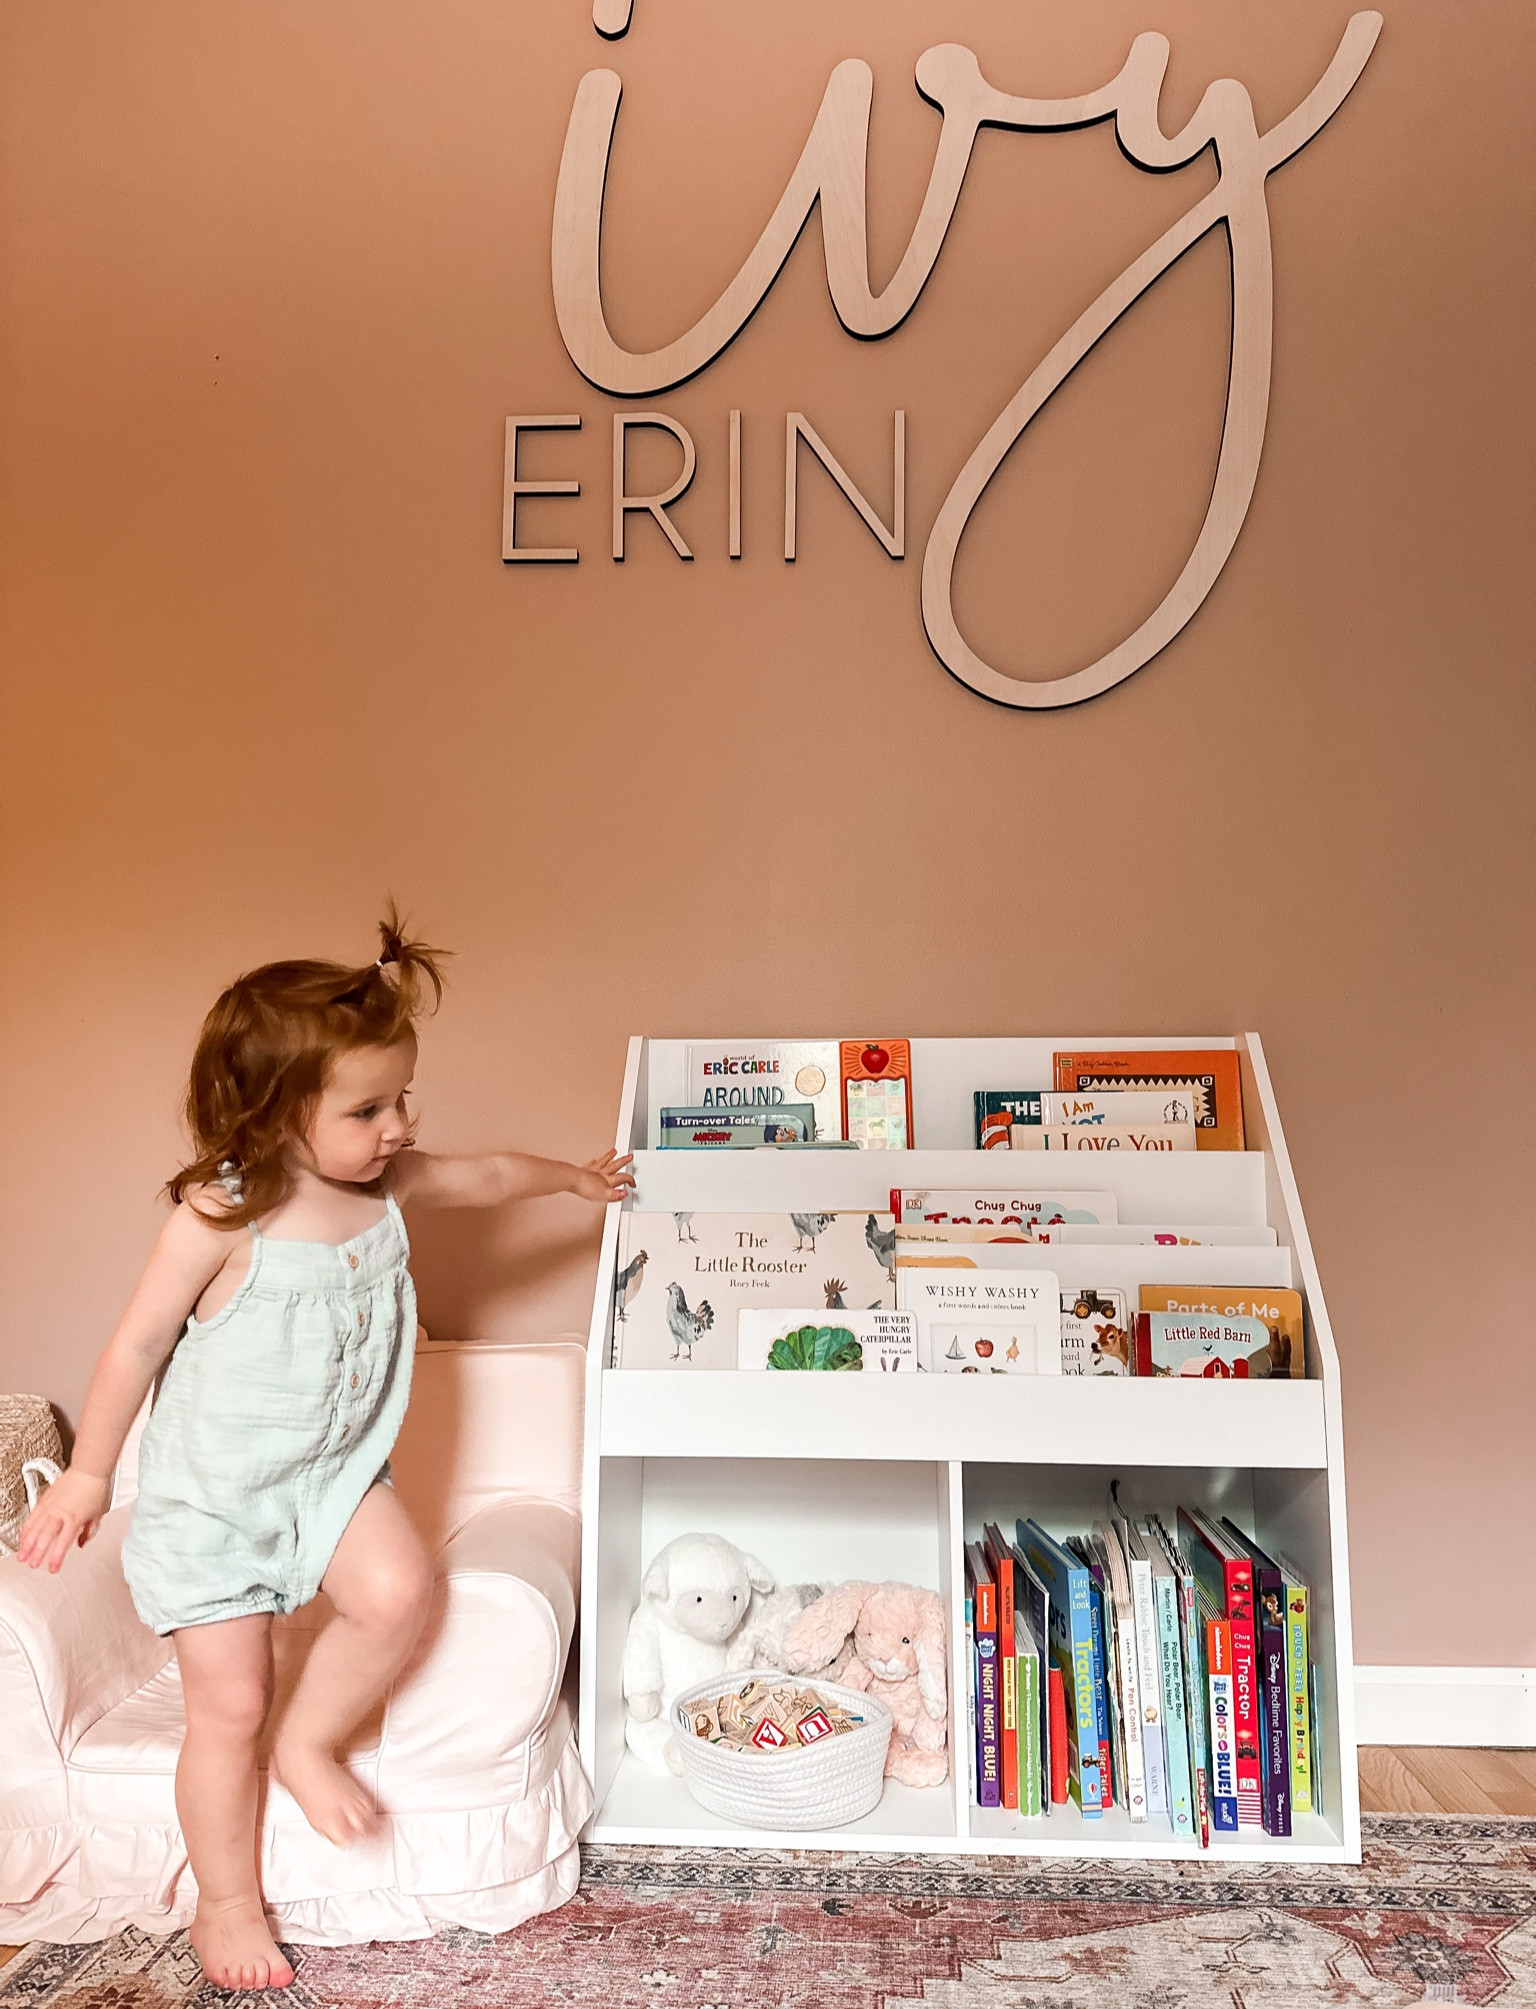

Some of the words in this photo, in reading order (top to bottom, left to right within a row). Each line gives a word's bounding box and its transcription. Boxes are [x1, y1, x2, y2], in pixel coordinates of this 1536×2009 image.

[550, 0, 1385, 712] ivy
[502, 410, 906, 564] ERIN
[741, 1060, 780, 1075] CARLE
[703, 1085, 784, 1108] AROUND
[1001, 1101, 1040, 1116] THE
[1062, 1102, 1069, 1117] I
[1072, 1099, 1094, 1116] Am
[675, 1117, 727, 1126] Turn-over
[729, 1116, 756, 1126] Tales
[1127, 1134, 1173, 1150] You
[906, 1199, 921, 1210] DK
[975, 1200, 1005, 1212] Chug
[1011, 1200, 1042, 1212] Chug
[735, 1232, 767, 1248] The
[695, 1256, 738, 1273] Little
[742, 1256, 807, 1274] Rooster
[730, 1279, 750, 1289] Rory
[926, 1285, 977, 1297] WISHY
[985, 1286, 1039, 1299] WASHY
[1166, 1300, 1219, 1315] Parts
[1224, 1302, 1246, 1317] of
[1251, 1302, 1280, 1318] Me
[873, 1316, 889, 1324] THE
[890, 1316, 911, 1324] VERY
[1066, 1320, 1081, 1330] first
[879, 1325, 911, 1334] HUNGRY
[1164, 1326, 1196, 1341] Little
[1198, 1326, 1221, 1341] Red
[1223, 1327, 1252, 1343] Barn
[860, 1335, 912, 1344] CATERPILLAR
[1061, 1337, 1085, 1348] rm
[1061, 1351, 1080, 1361] oard
[1062, 1362, 1085, 1376] ook
[1073, 1578, 1087, 1588] Lift
[1074, 1591, 1086, 1600] and
[1072, 1600, 1089, 1610] Look
[1140, 1597, 1149, 1625] Rabbit
[1142, 1628, 1150, 1653] Touch
[1234, 1633, 1250, 1641] Chug
[1234, 1642, 1251, 1650] Chug
[1293, 1624, 1304, 1658] TOUCH
[1214, 1626, 1223, 1670] nickelodeon
[1143, 1655, 1152, 1671] and
[1164, 1661, 1170, 1672] Do
[1268, 1652, 1281, 1683] Disney
[982, 1664, 994, 1700] NIGHT
[1075, 1637, 1094, 1729] Tractors
[1144, 1673, 1153, 1690] Feel
[1237, 1655, 1251, 1720] Tractor
[1294, 1667, 1304, 1692] FEEL
[1094, 1678, 1102, 1701] Bear
[1271, 1686, 1281, 1727] Bedtime
[1294, 1696, 1305, 1727] Happy
[982, 1703, 995, 1742] NIGHT,
[1129, 1708, 1138, 1743] Control
[1215, 1697, 1228, 1739] Colors
[1099, 1748, 1108, 1771] tiger
[1273, 1730, 1283, 1775] Favorites
[983, 1745, 996, 1781] BLUE!
[1151, 1765, 1159, 1797] WARNE
[1217, 1752, 1232, 1795] BLUE!
[1101, 1773, 1109, 1797] tales
[1241, 1779, 1256, 1789] DK
